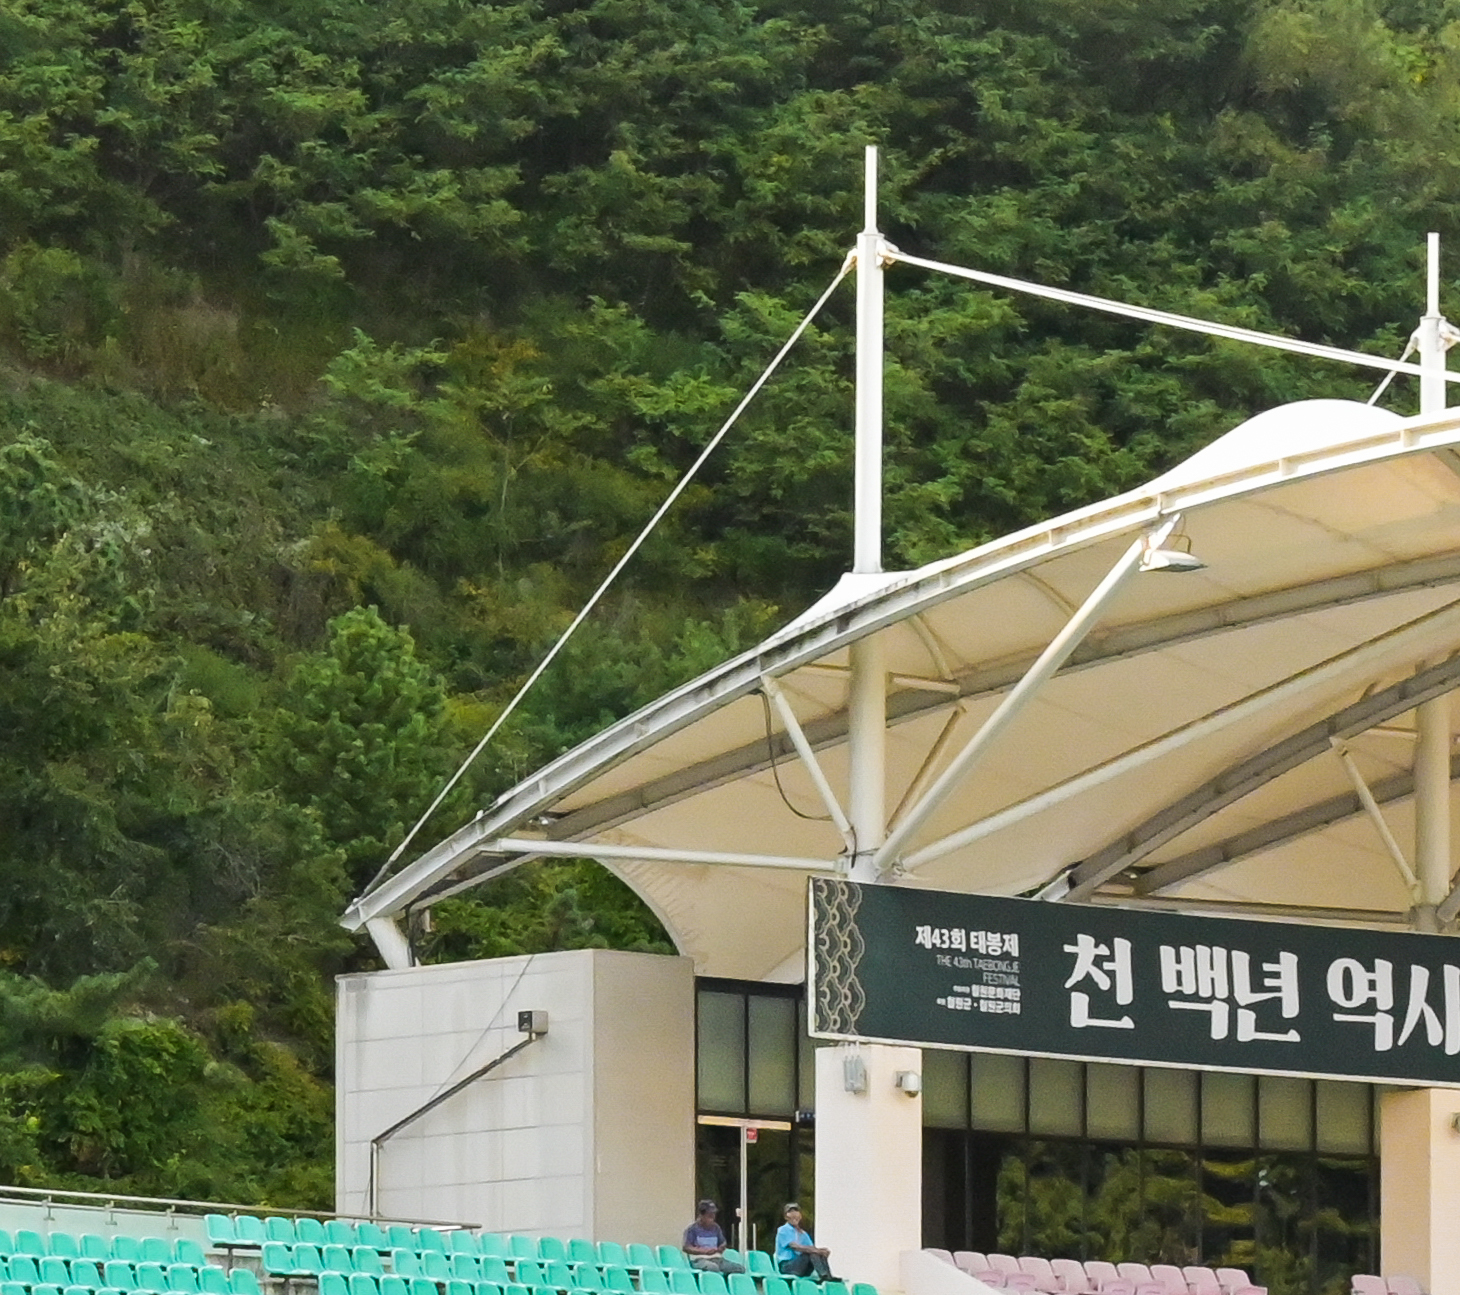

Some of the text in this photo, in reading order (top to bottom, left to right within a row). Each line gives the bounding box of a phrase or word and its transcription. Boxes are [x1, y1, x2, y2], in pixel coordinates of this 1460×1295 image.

[915, 925, 1019, 957] 제43회 태봉제
[1063, 933, 1135, 1029] 천
[1159, 944, 1301, 1043] 백년
